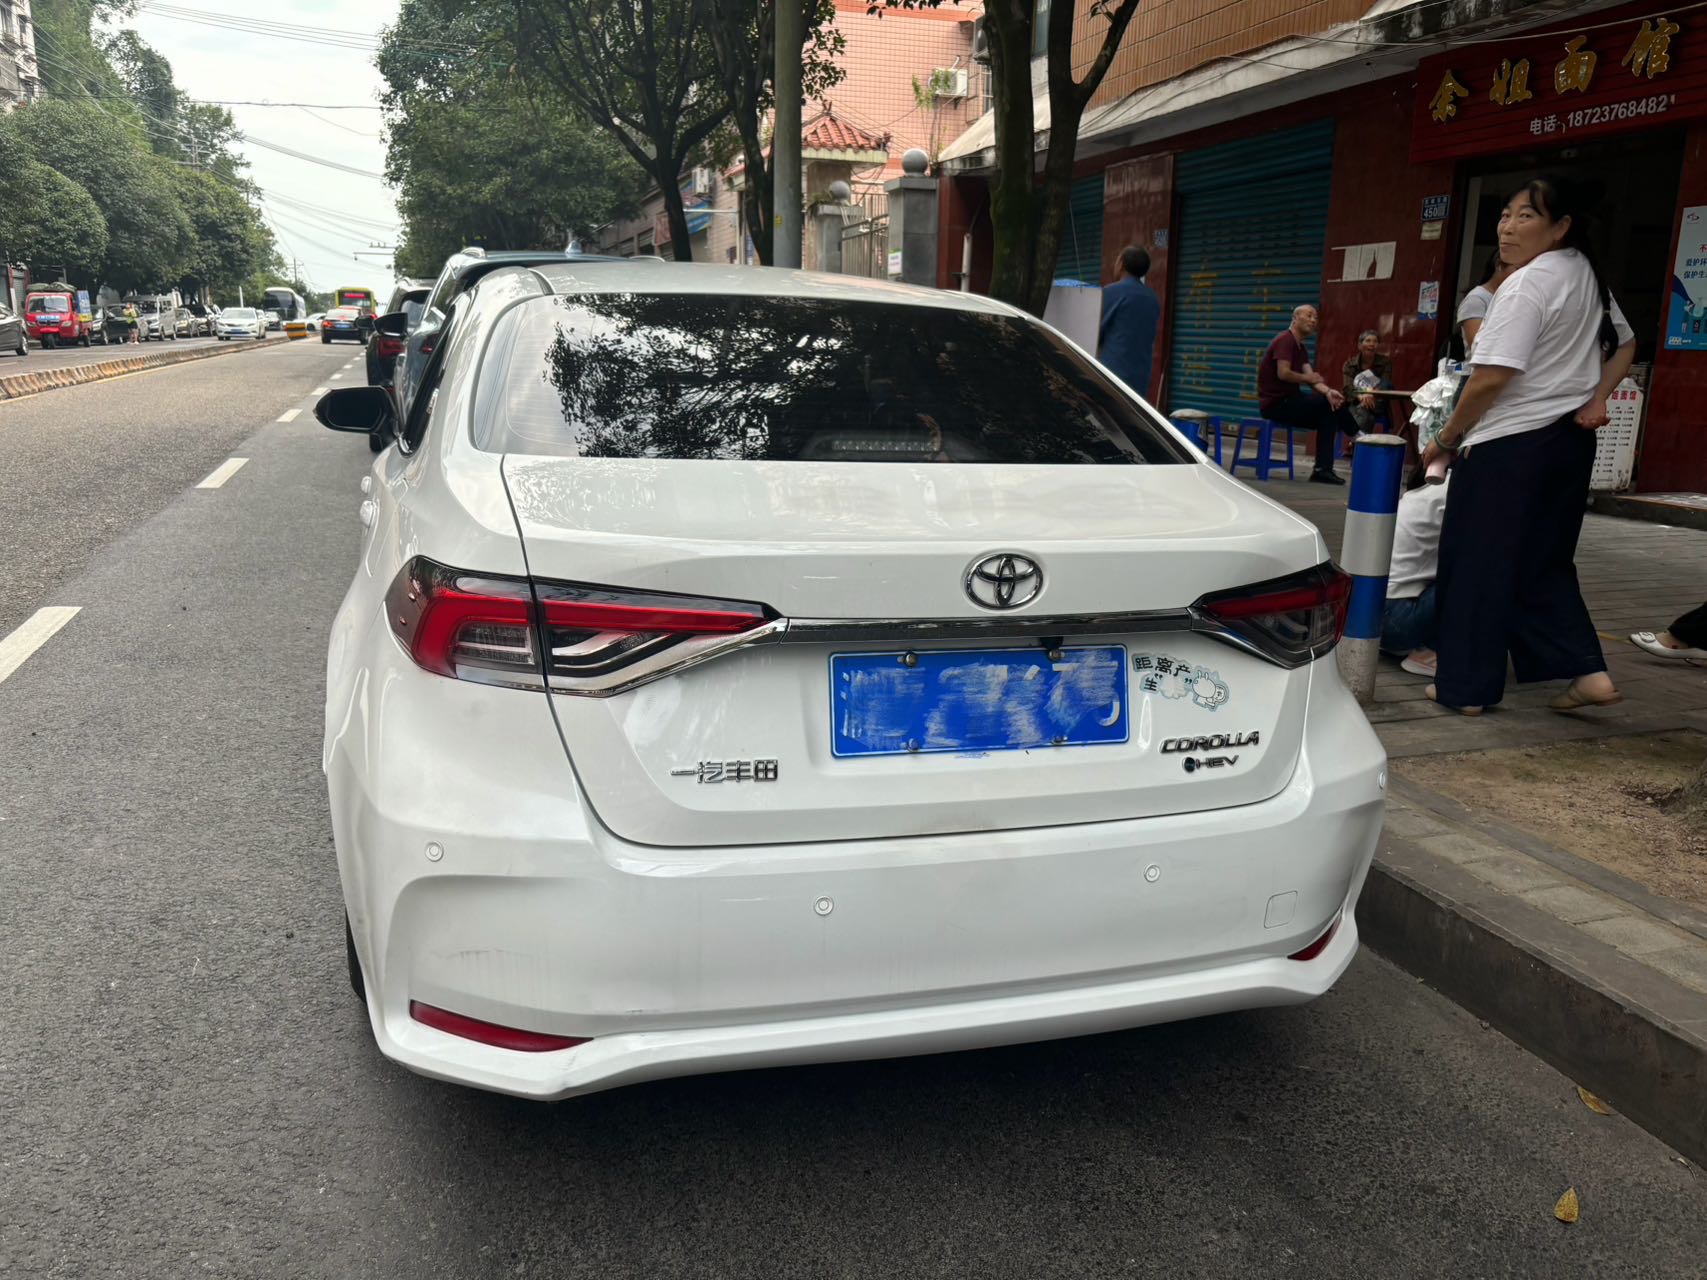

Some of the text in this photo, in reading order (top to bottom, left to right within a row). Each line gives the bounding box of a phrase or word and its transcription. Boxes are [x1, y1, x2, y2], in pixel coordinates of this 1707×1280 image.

[1568, 94, 1669, 128] 18723768482
[1160, 731, 1260, 754] COROLLA
[670, 759, 778, 783] 一汽丰田
[1195, 755, 1239, 769] HEV
